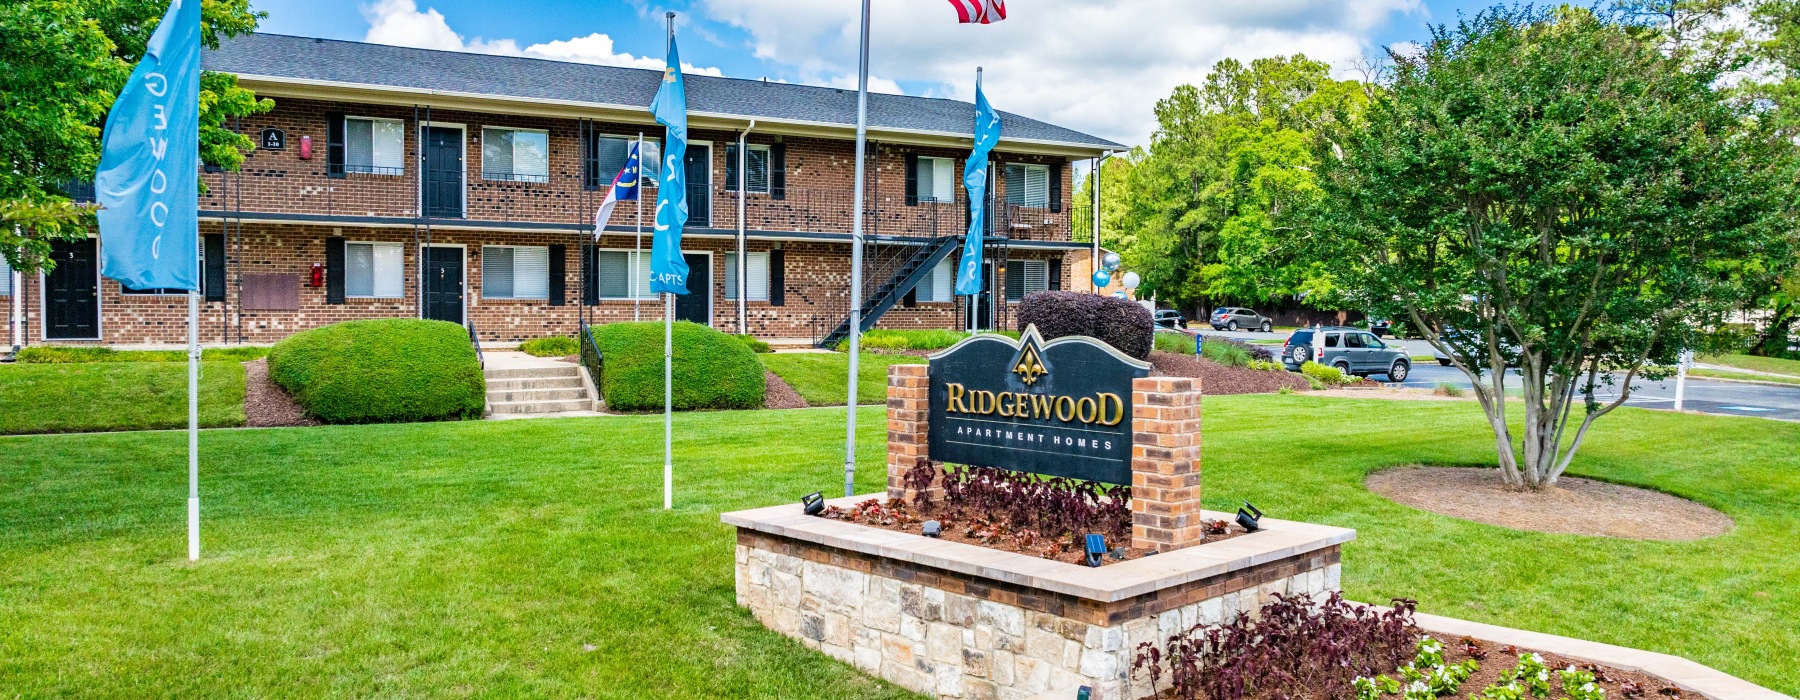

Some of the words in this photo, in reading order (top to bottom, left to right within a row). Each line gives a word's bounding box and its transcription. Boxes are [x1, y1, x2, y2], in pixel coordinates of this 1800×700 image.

[268, 131, 278, 141] A
[945, 382, 1125, 427] RIDGEWOOD
[957, 426, 1045, 443] APARTMENT
[1053, 435, 1112, 450] HOMES
